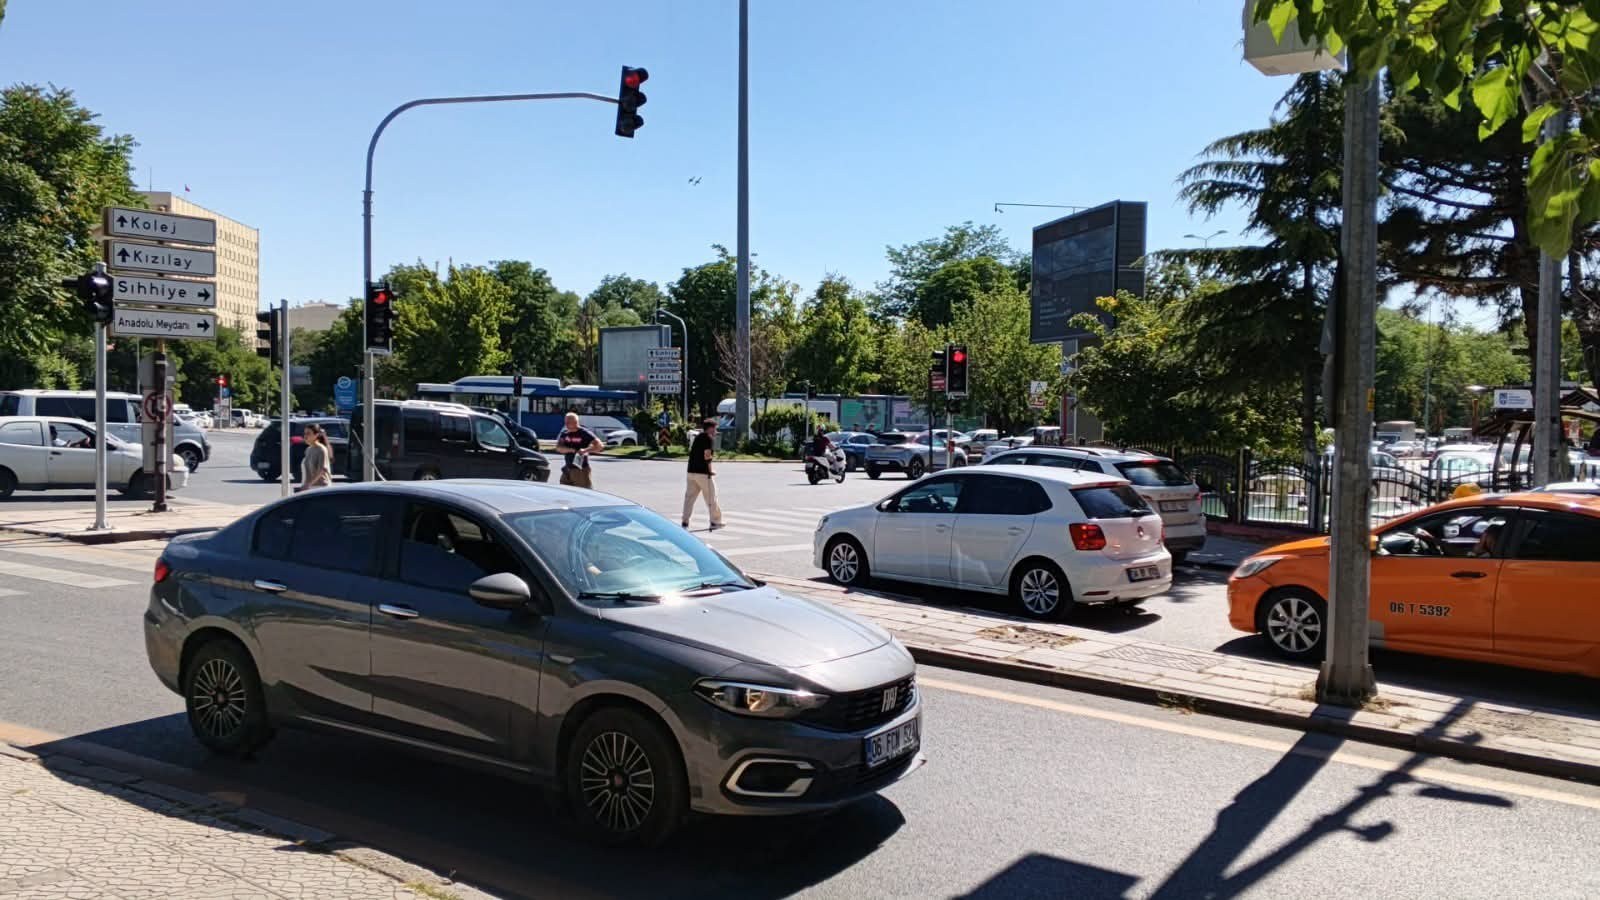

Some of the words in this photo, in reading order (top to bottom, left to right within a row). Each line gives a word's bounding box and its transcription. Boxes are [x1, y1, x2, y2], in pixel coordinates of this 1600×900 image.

[131, 216, 177, 235] Kolej
[133, 250, 192, 270] Kızılay
[118, 281, 187, 300] Sıhhiye
[118, 317, 154, 329] Anadolu
[156, 319, 190, 331] Meydanı
[1389, 601, 1405, 614] 06
[1409, 603, 1416, 615] T
[1419, 604, 1451, 616] 5392
[872, 738, 882, 758] 06
